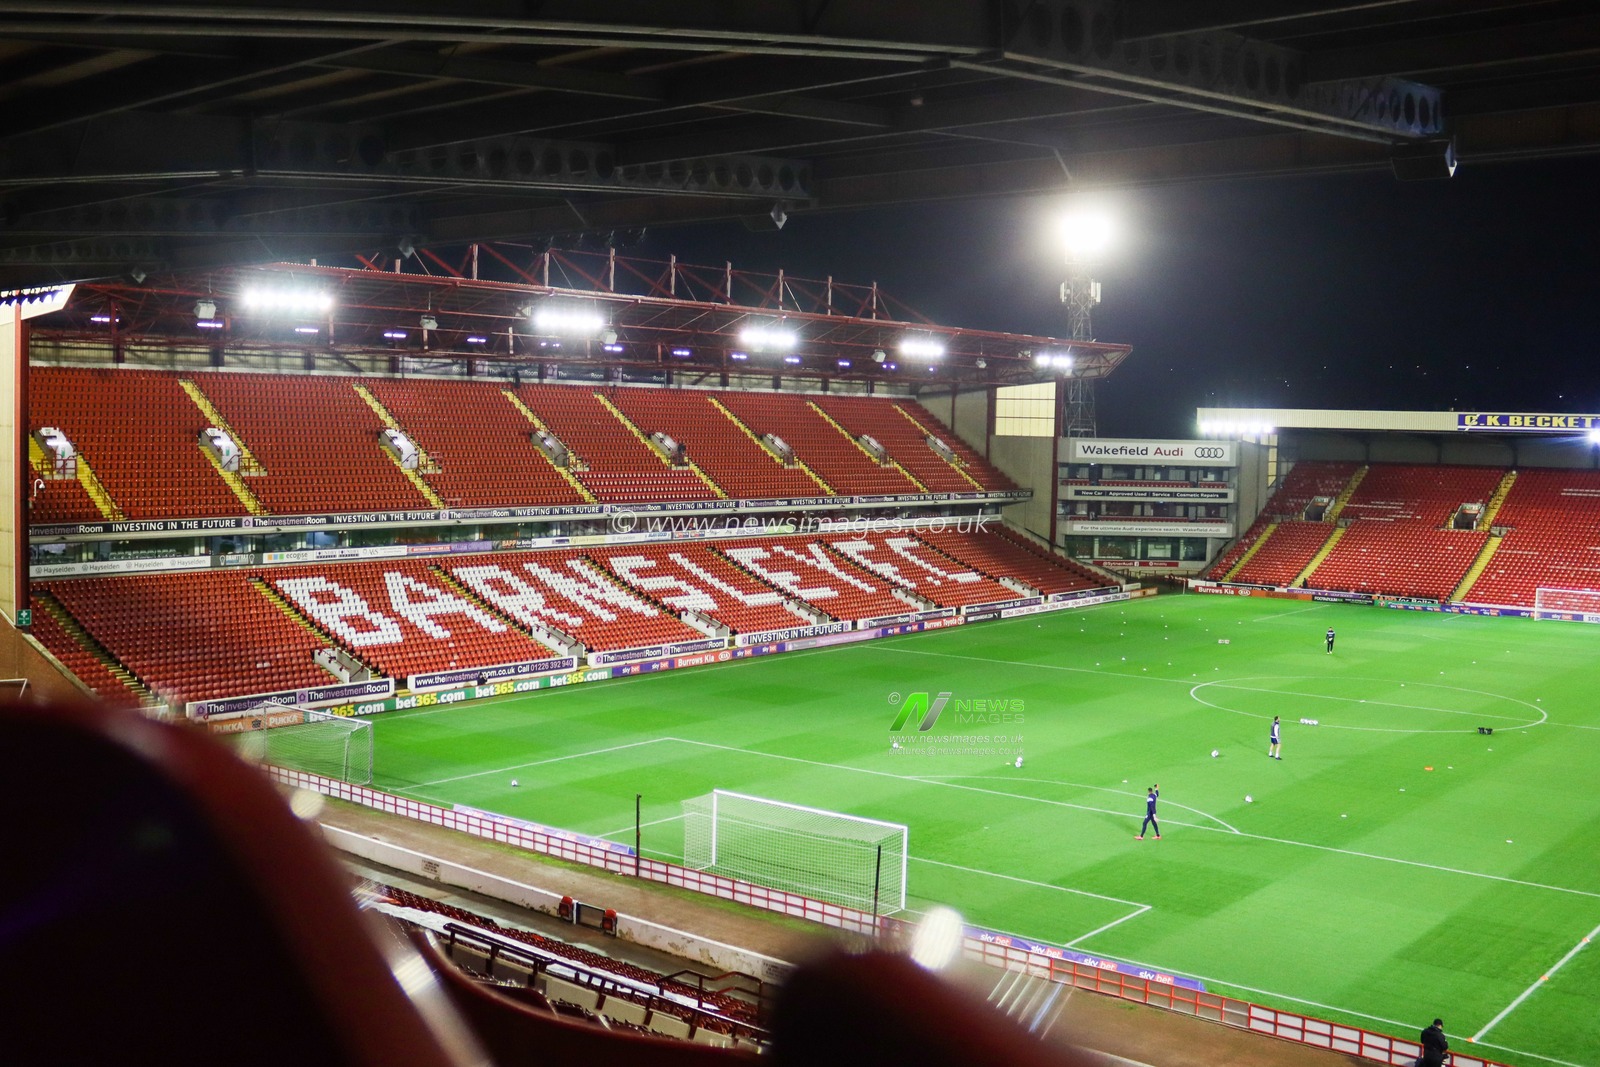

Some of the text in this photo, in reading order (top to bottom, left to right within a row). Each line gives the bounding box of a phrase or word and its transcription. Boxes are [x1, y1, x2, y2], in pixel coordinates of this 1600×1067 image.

[1464, 415, 1600, 428] C.K.BECKET
[1082, 445, 1183, 457] Wakefield Audi
[666, 502, 695, 510] INVESTING
[716, 501, 736, 509] FUTURE
[791, 498, 816, 506] INVESTING
[254, 512, 435, 527] TheInvestmentRoom INVESTING IN THE FUTURE
[450, 510, 510, 520] TheInvestmentRoom
[515, 508, 550, 517] INVESTING
[553, 507, 560, 515] IN
[576, 506, 600, 514] FUTURE
[112, 522, 164, 532] INVESTING
[167, 521, 177, 530] IN
[181, 520, 199, 529] THE
[202, 519, 236, 529] FUTURE
[90, 563, 120, 573] Hayselden
[134, 561, 164, 570] Hayselden
[177, 559, 206, 568] Hayselden
[43, 566, 76, 576] Hayselden
[276, 544, 876, 647] BARNSLEY
[1198, 586, 1223, 594] Burrows
[924, 619, 957, 629] Burrows Toyota
[750, 631, 789, 643] INVESTING
[791, 630, 798, 639] IN
[800, 628, 813, 638] THE
[814, 624, 843, 636] FUTURE
[670, 640, 724, 654] TheInvestmentRoom
[603, 649, 662, 663] TheInvestmentRoom
[737, 650, 745, 658] sky
[652, 663, 660, 671] sky
[678, 657, 703, 668] Burrows
[704, 655, 715, 664] Kia
[416, 660, 573, 686] www.theinvestmenoom.co.uk Call 01226 392 940
[622, 665, 640, 675] sky bet
[550, 670, 608, 687] bet365.com
[309, 684, 389, 701] TheInvestmentRoom
[475, 679, 540, 698] bet365.com
[396, 690, 466, 710] bet365.com
[269, 714, 299, 725] PUKKA
[589, 839, 600, 847] sky
[980, 933, 1010, 946] sky bet
[1031, 944, 1062, 958] sky bet
[1084, 957, 1116, 971] sky bet
[1139, 970, 1173, 984] sky bet
